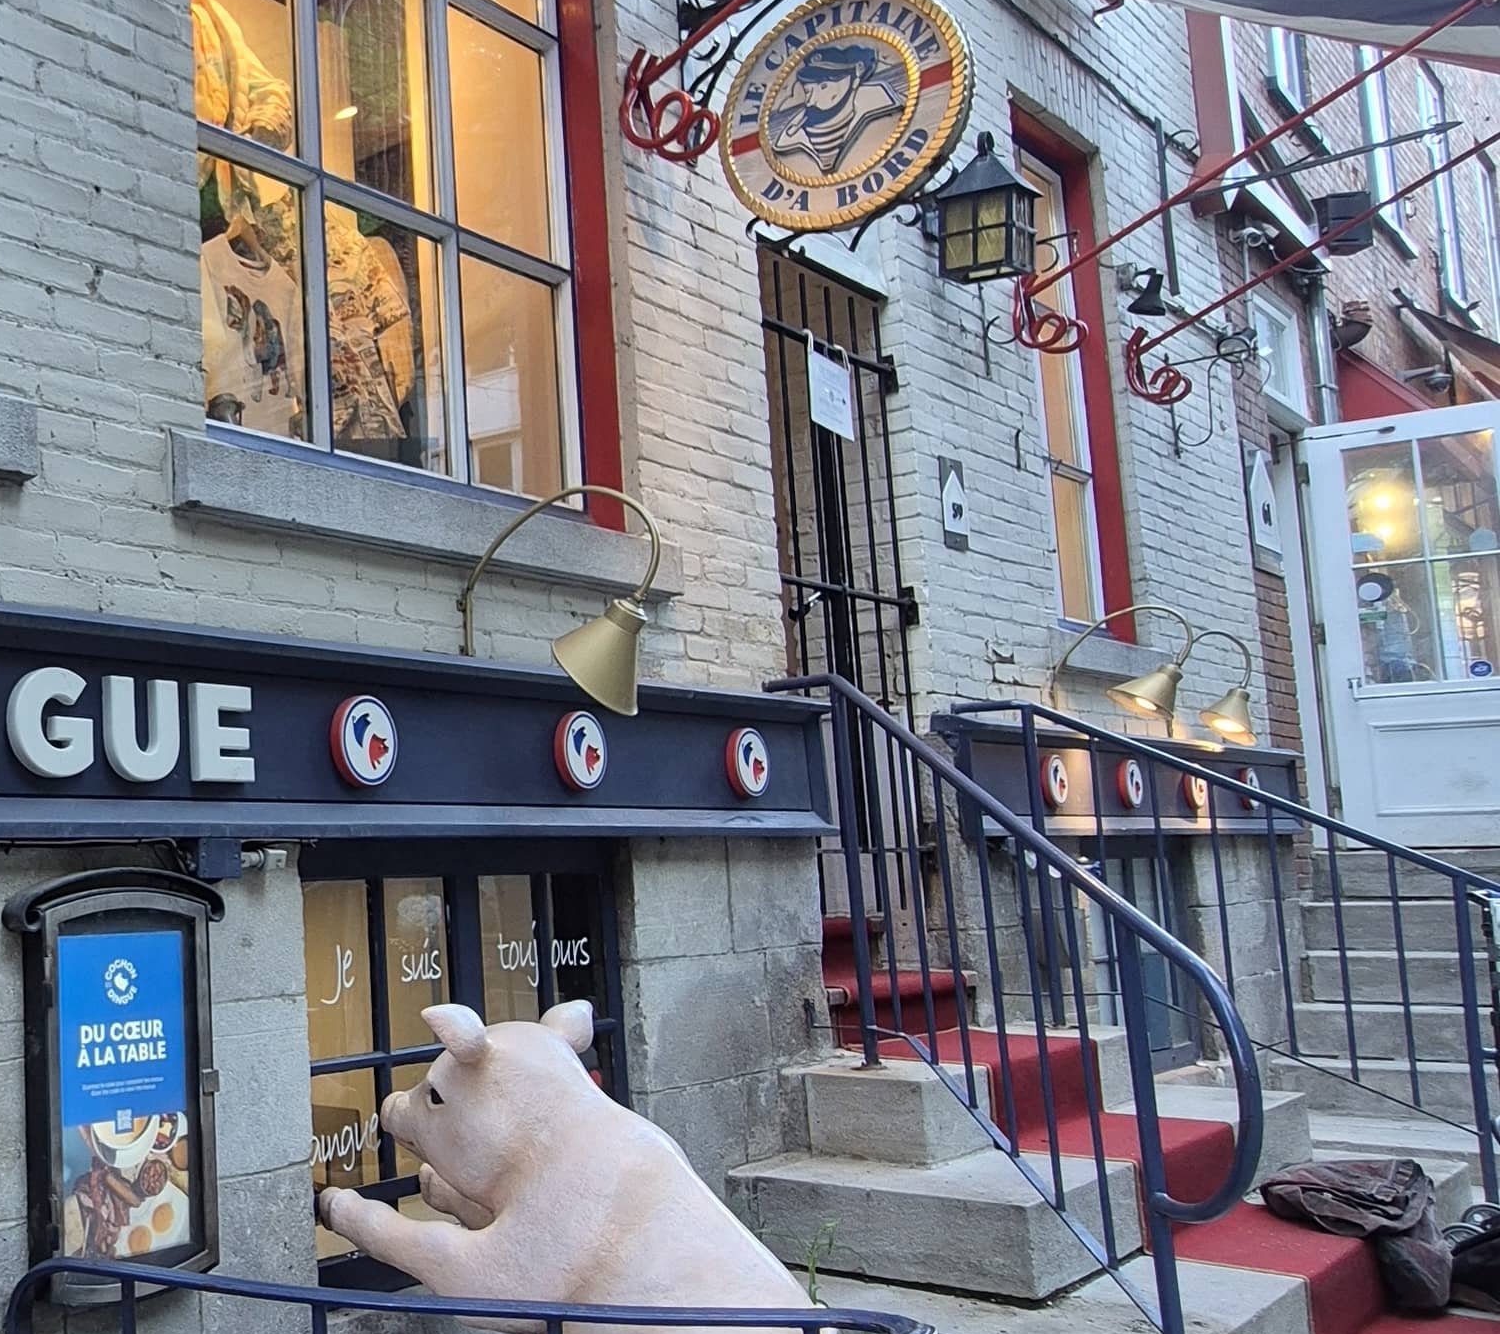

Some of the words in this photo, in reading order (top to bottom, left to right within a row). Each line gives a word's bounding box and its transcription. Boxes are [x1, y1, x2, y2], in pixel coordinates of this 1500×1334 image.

[739, 81, 767, 124] LE
[765, 0, 942, 71] CAPITAINE
[836, 128, 929, 208] BORD
[951, 502, 963, 521] 59
[104, 959, 138, 981] COCHON
[401, 937, 443, 983] suis
[106, 985, 138, 1005] DINGUE
[80, 1024, 105, 1044] DU
[110, 1019, 164, 1041] CŒUR
[77, 1044, 91, 1068] À
[94, 1045, 116, 1066] LA
[118, 1040, 167, 1063] TABLE
